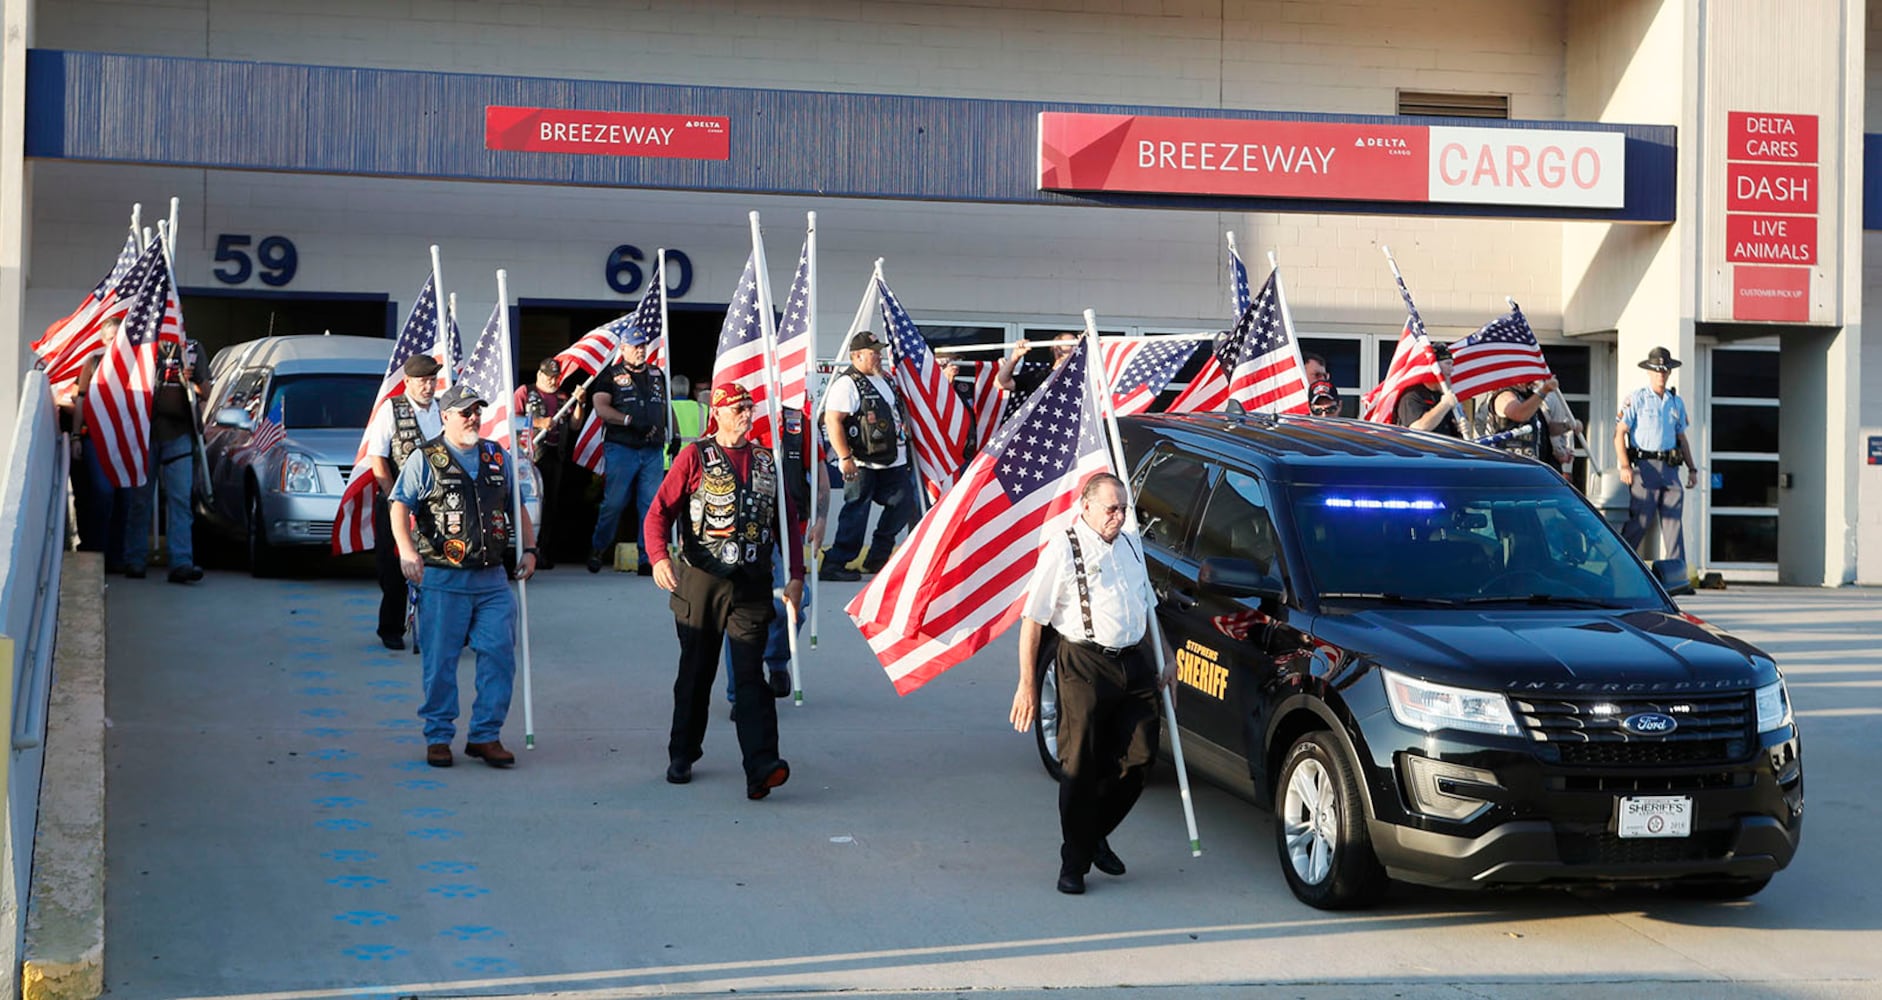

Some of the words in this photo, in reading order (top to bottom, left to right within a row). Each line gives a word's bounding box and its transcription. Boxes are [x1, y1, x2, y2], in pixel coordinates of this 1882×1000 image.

[540, 122, 674, 146] BREEZEWAY
[1746, 117, 1795, 134] DELTA
[1367, 138, 1406, 148] DELTA
[1746, 139, 1799, 158] CARES
[1138, 140, 1336, 174] BREEZEWAY
[1439, 142, 1601, 189] CARGO
[1736, 175, 1809, 202] DASH
[1752, 220, 1788, 237] LIVE
[213, 234, 298, 287] 59
[1733, 242, 1809, 260] ANIMALS
[605, 244, 693, 299] 60
[1186, 640, 1219, 661] STEPHENS
[1176, 648, 1229, 700] SHERIFF
[1507, 679, 1750, 691] INTERCEPTOR
[1637, 716, 1667, 731] Ford
